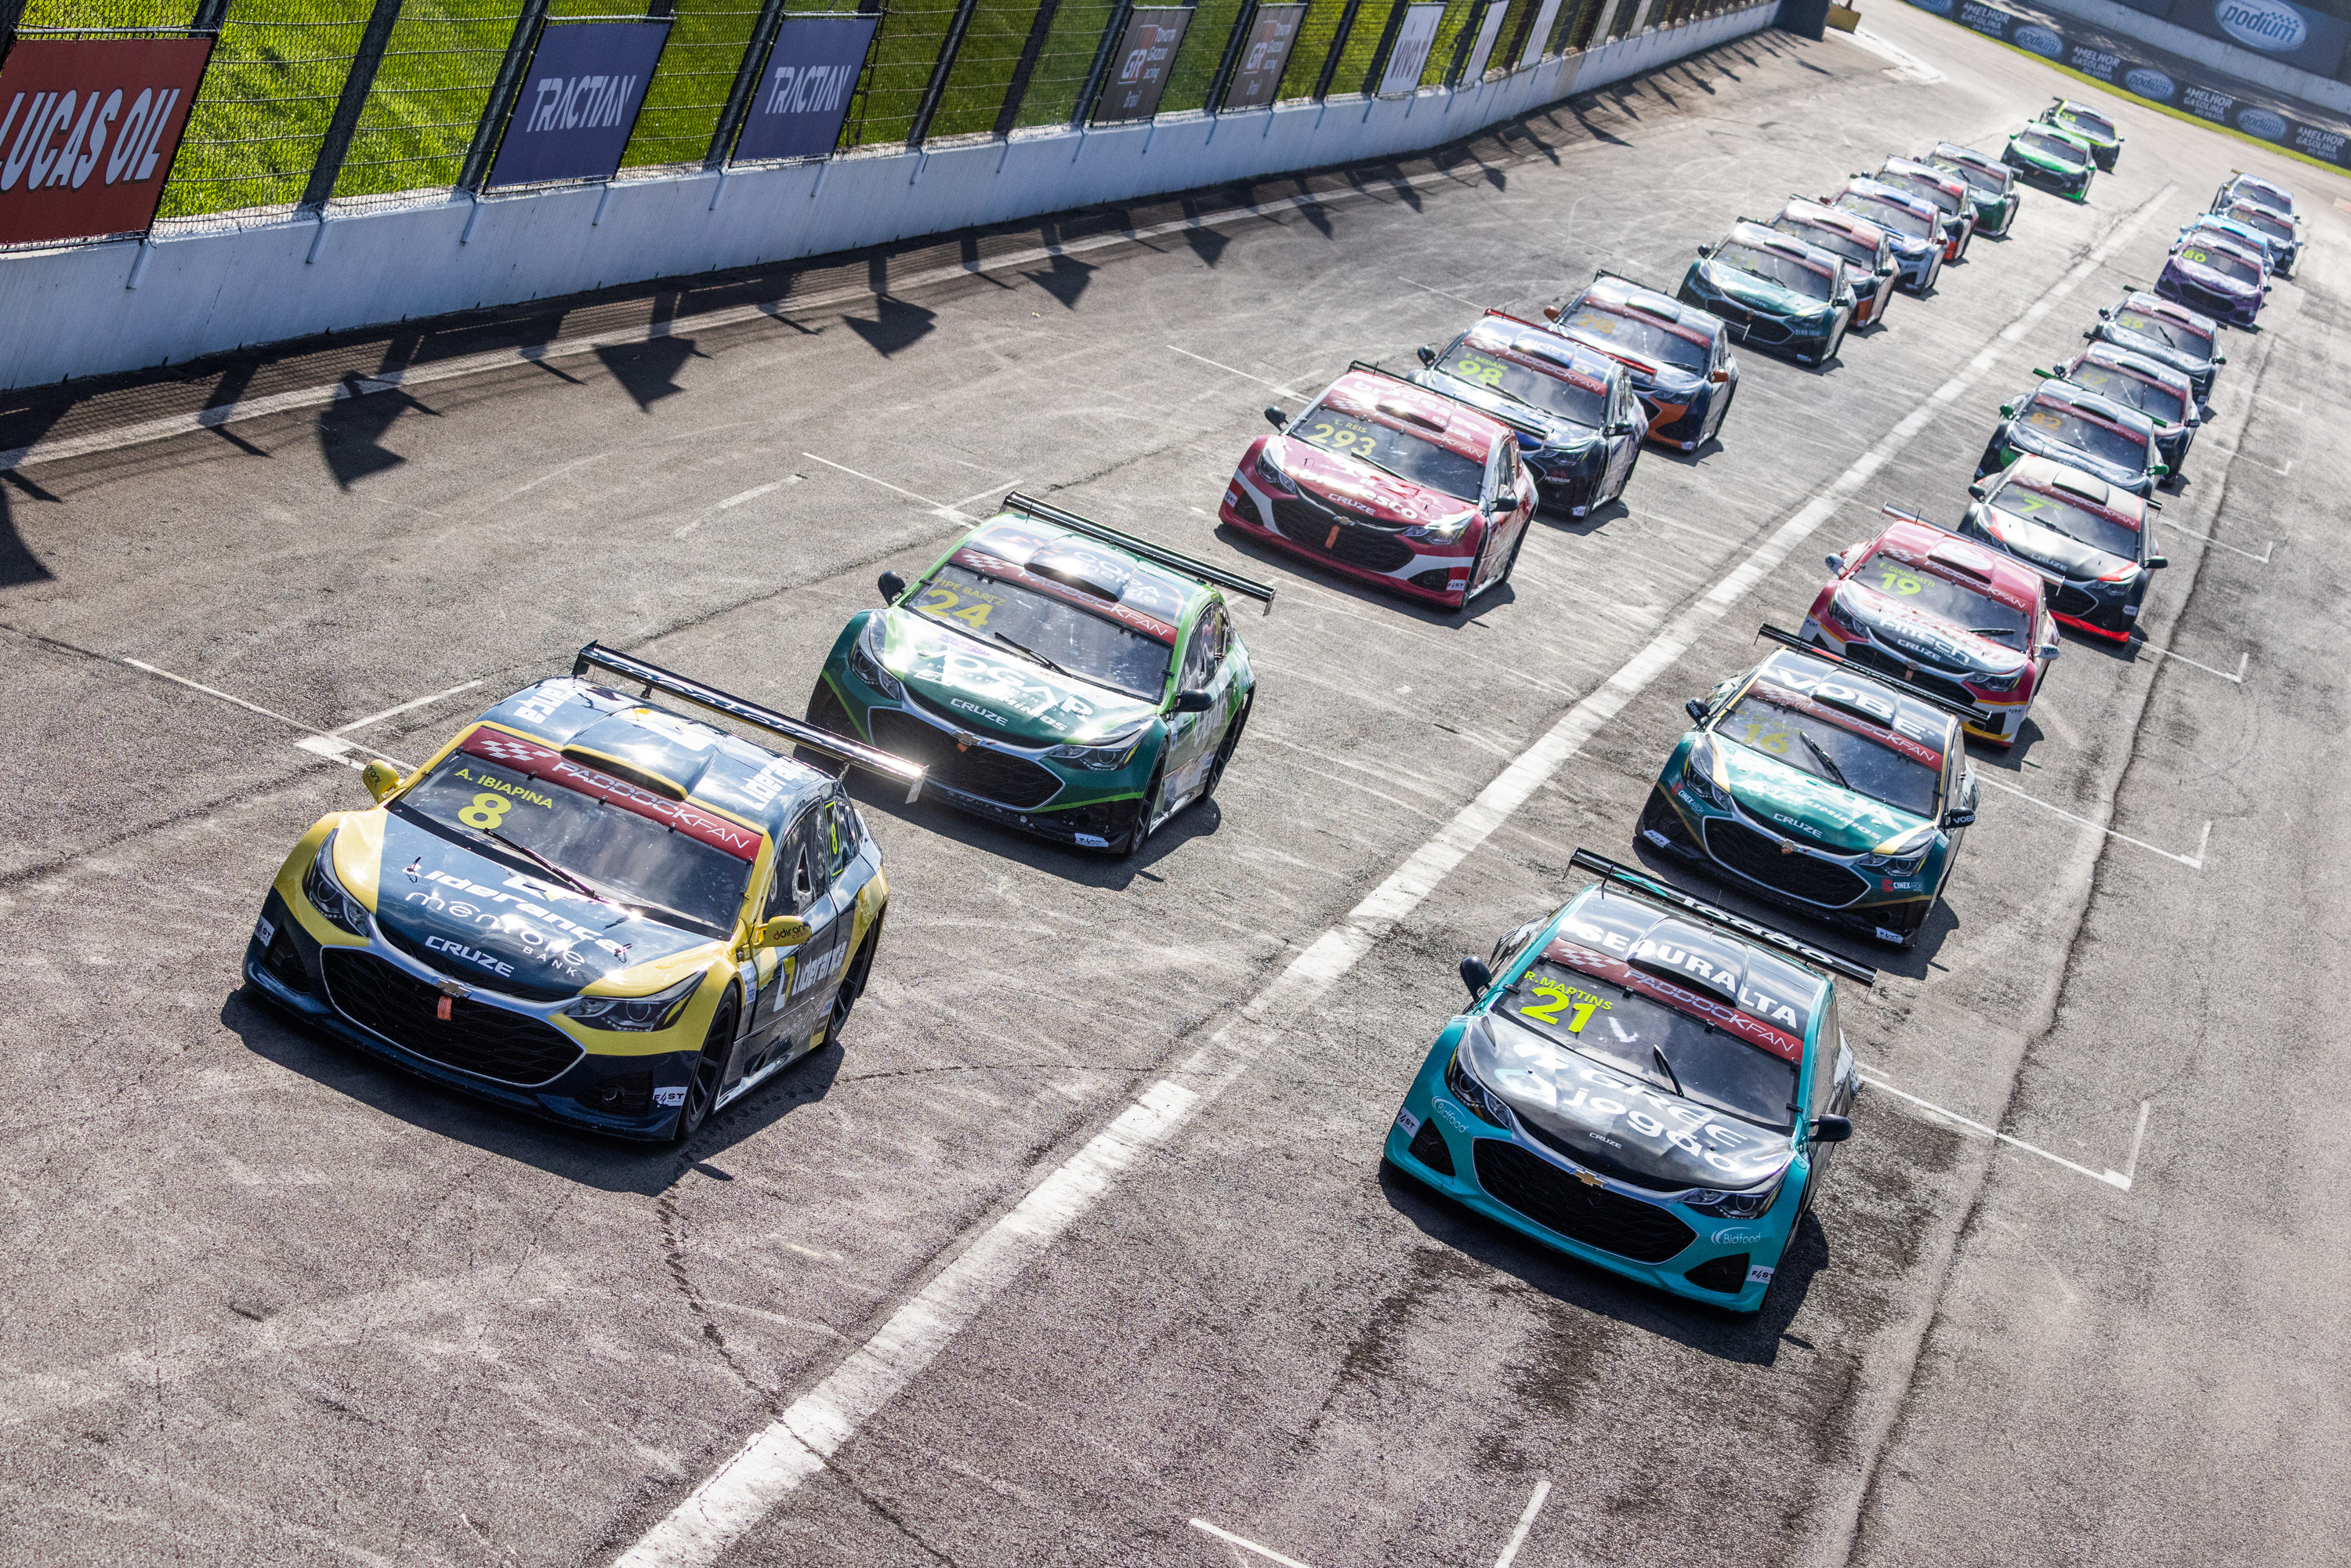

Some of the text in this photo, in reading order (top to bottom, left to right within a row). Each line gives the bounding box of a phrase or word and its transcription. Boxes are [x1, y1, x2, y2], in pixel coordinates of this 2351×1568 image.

[2221, 5, 2297, 42] podium
[526, 75, 636, 132] TRACTIAN
[765, 65, 851, 114] TRACTIAN
[0, 88, 181, 192] LUCAS OIL
[2183, 250, 2207, 263] 80
[1577, 313, 1616, 333] 218
[1457, 360, 1502, 385] 98
[1474, 355, 1508, 371] BEDANI
[1345, 422, 1367, 433] REIS
[2030, 412, 2062, 431] 82
[1306, 423, 1377, 457] 293
[1299, 470, 1418, 520] bresco
[1328, 493, 1375, 515] CRUZE
[2019, 498, 2045, 512] 7
[2030, 553, 2068, 572] CRUZE
[962, 587, 1006, 607] BARTZ
[1881, 573, 1922, 596] 19
[1925, 559, 2026, 609] PADDOCKFAN
[915, 589, 994, 628] 24
[1019, 570, 1168, 637] PADDOCKFAN
[1897, 639, 1941, 661] CRUZE
[951, 697, 1009, 726] CRUZE
[1744, 723, 1791, 754] 16
[1816, 704, 1935, 762] ADDOCKFAN
[455, 767, 552, 809] A. IBIAPINA
[458, 792, 512, 829] 8
[552, 762, 749, 849] PADDOCKFAN
[831, 823, 838, 855] 8
[1773, 813, 1822, 838] CRUZE
[425, 936, 515, 978] CRUZE
[522, 945, 578, 977] BANK
[1520, 987, 1597, 1033] 21
[1623, 969, 1795, 1052] PADDOCKFAN
[1437, 1102, 1469, 1133] Bidfood
[1589, 1132, 1622, 1150] CRUZE
[1722, 1232, 1761, 1244] Bidfood
